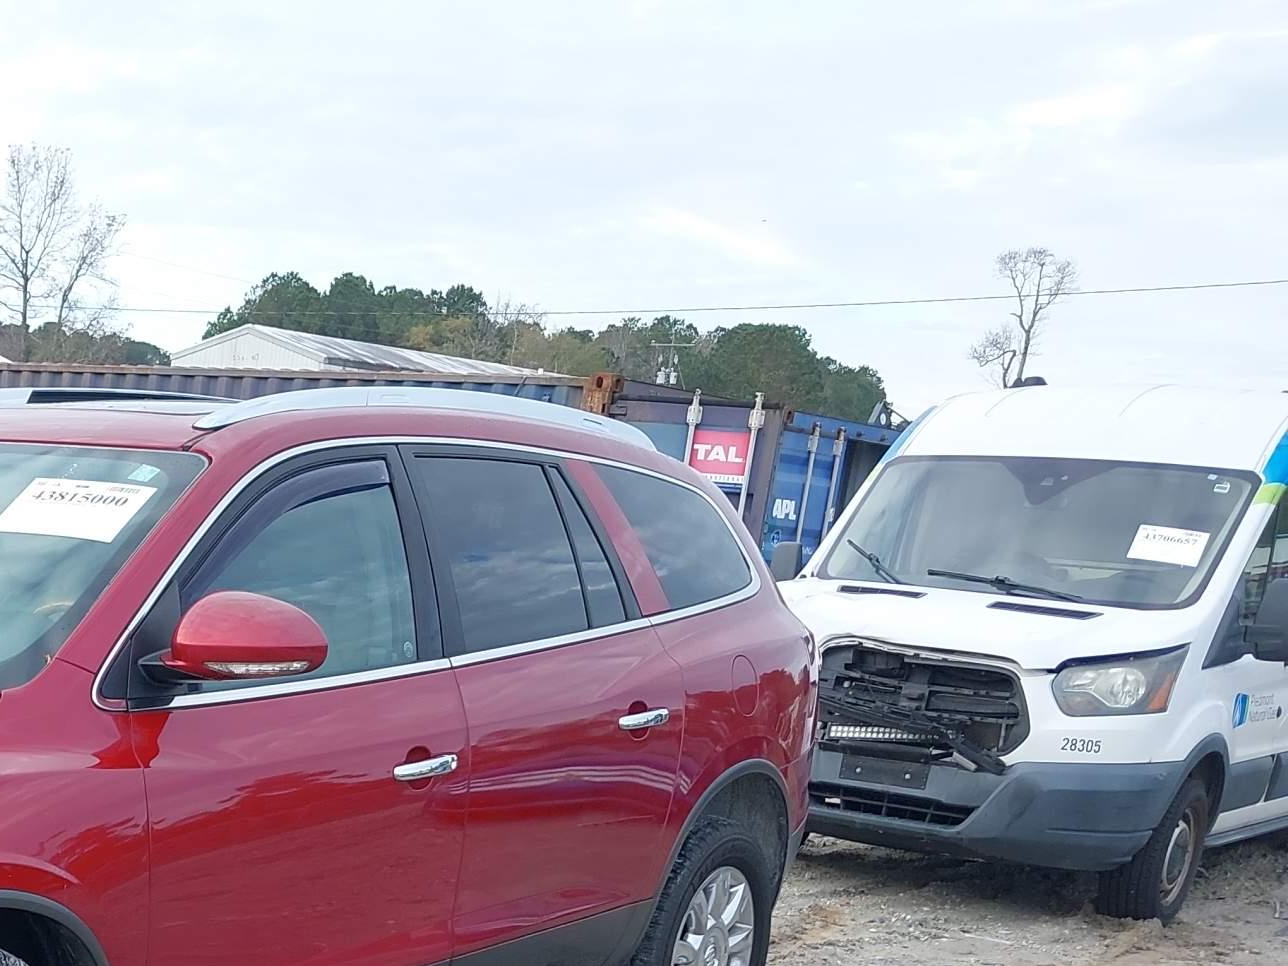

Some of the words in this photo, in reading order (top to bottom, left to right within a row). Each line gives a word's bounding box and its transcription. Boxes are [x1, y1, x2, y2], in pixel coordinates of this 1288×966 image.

[693, 443, 744, 463] TAL
[31, 489, 129, 507] 43815000
[772, 498, 797, 521] APL
[1061, 737, 1102, 753] 28305
